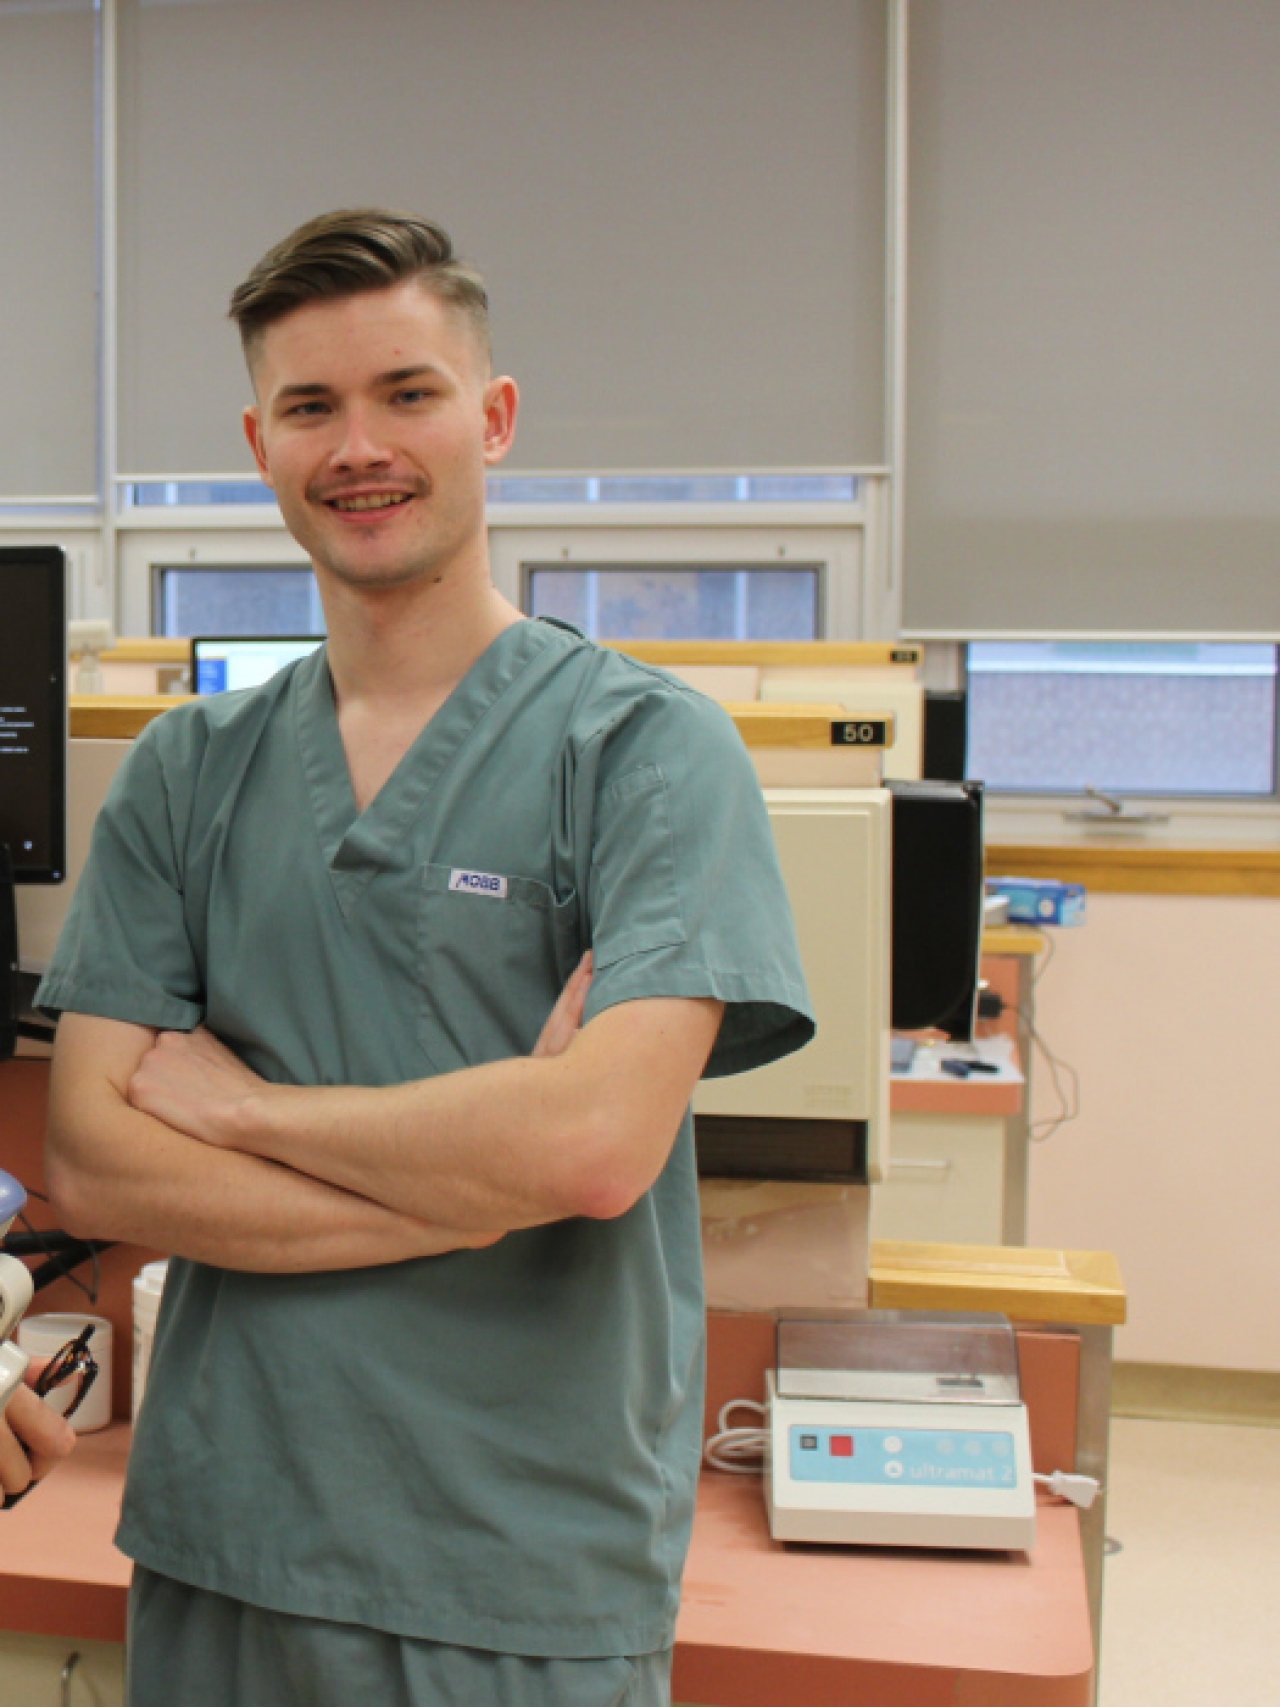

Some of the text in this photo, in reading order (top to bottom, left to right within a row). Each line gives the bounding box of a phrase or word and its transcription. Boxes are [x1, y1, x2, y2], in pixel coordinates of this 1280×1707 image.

[843, 723, 874, 742] 50
[909, 1463, 1014, 1482] ultramat 2
